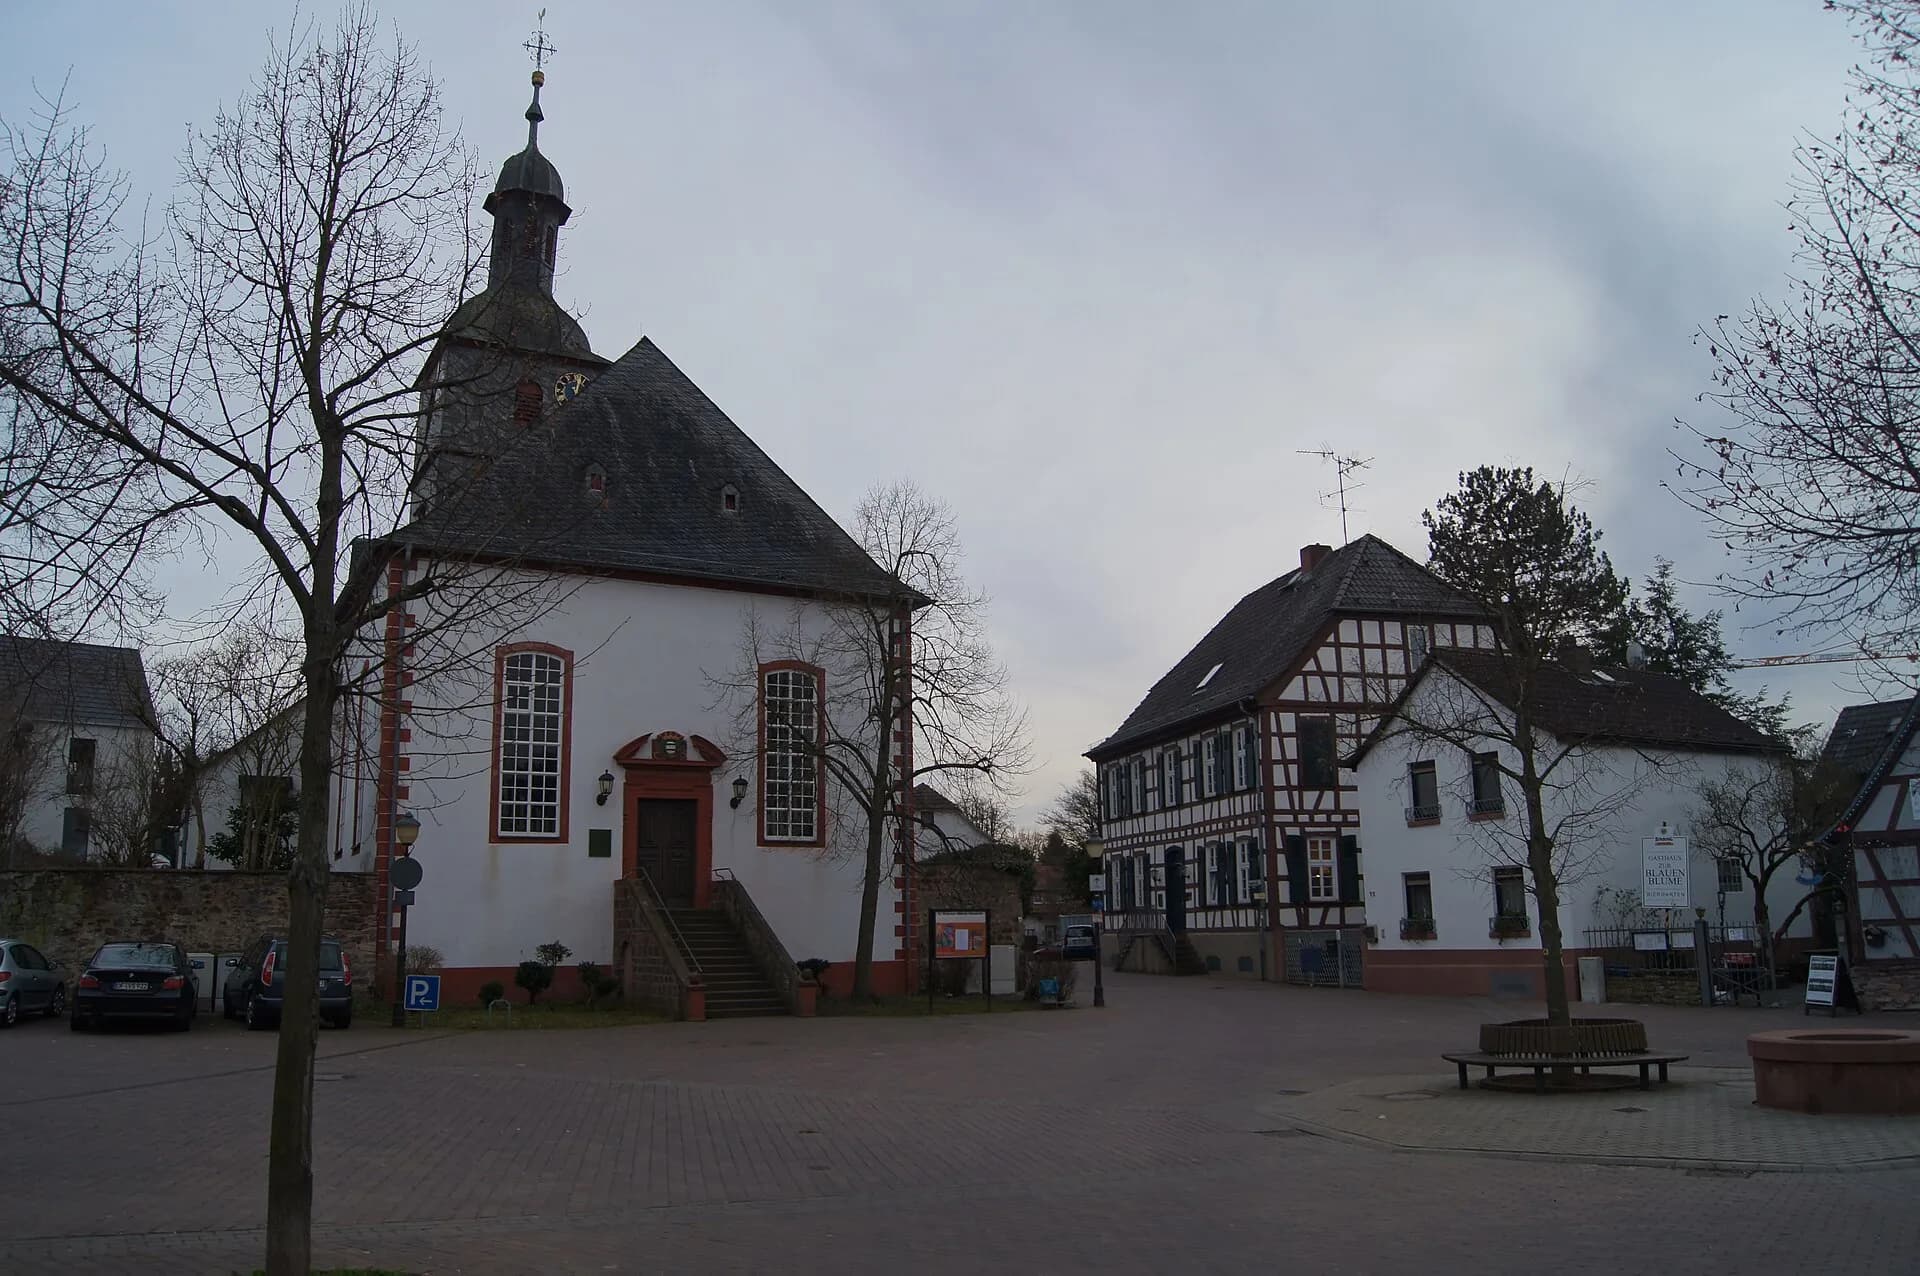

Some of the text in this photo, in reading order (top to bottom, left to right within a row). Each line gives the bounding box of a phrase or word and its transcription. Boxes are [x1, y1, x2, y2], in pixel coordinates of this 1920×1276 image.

[1645, 868, 1685, 877] BLAUEN
[1648, 877, 1682, 885] BLUME
[410, 980, 429, 1005] P
